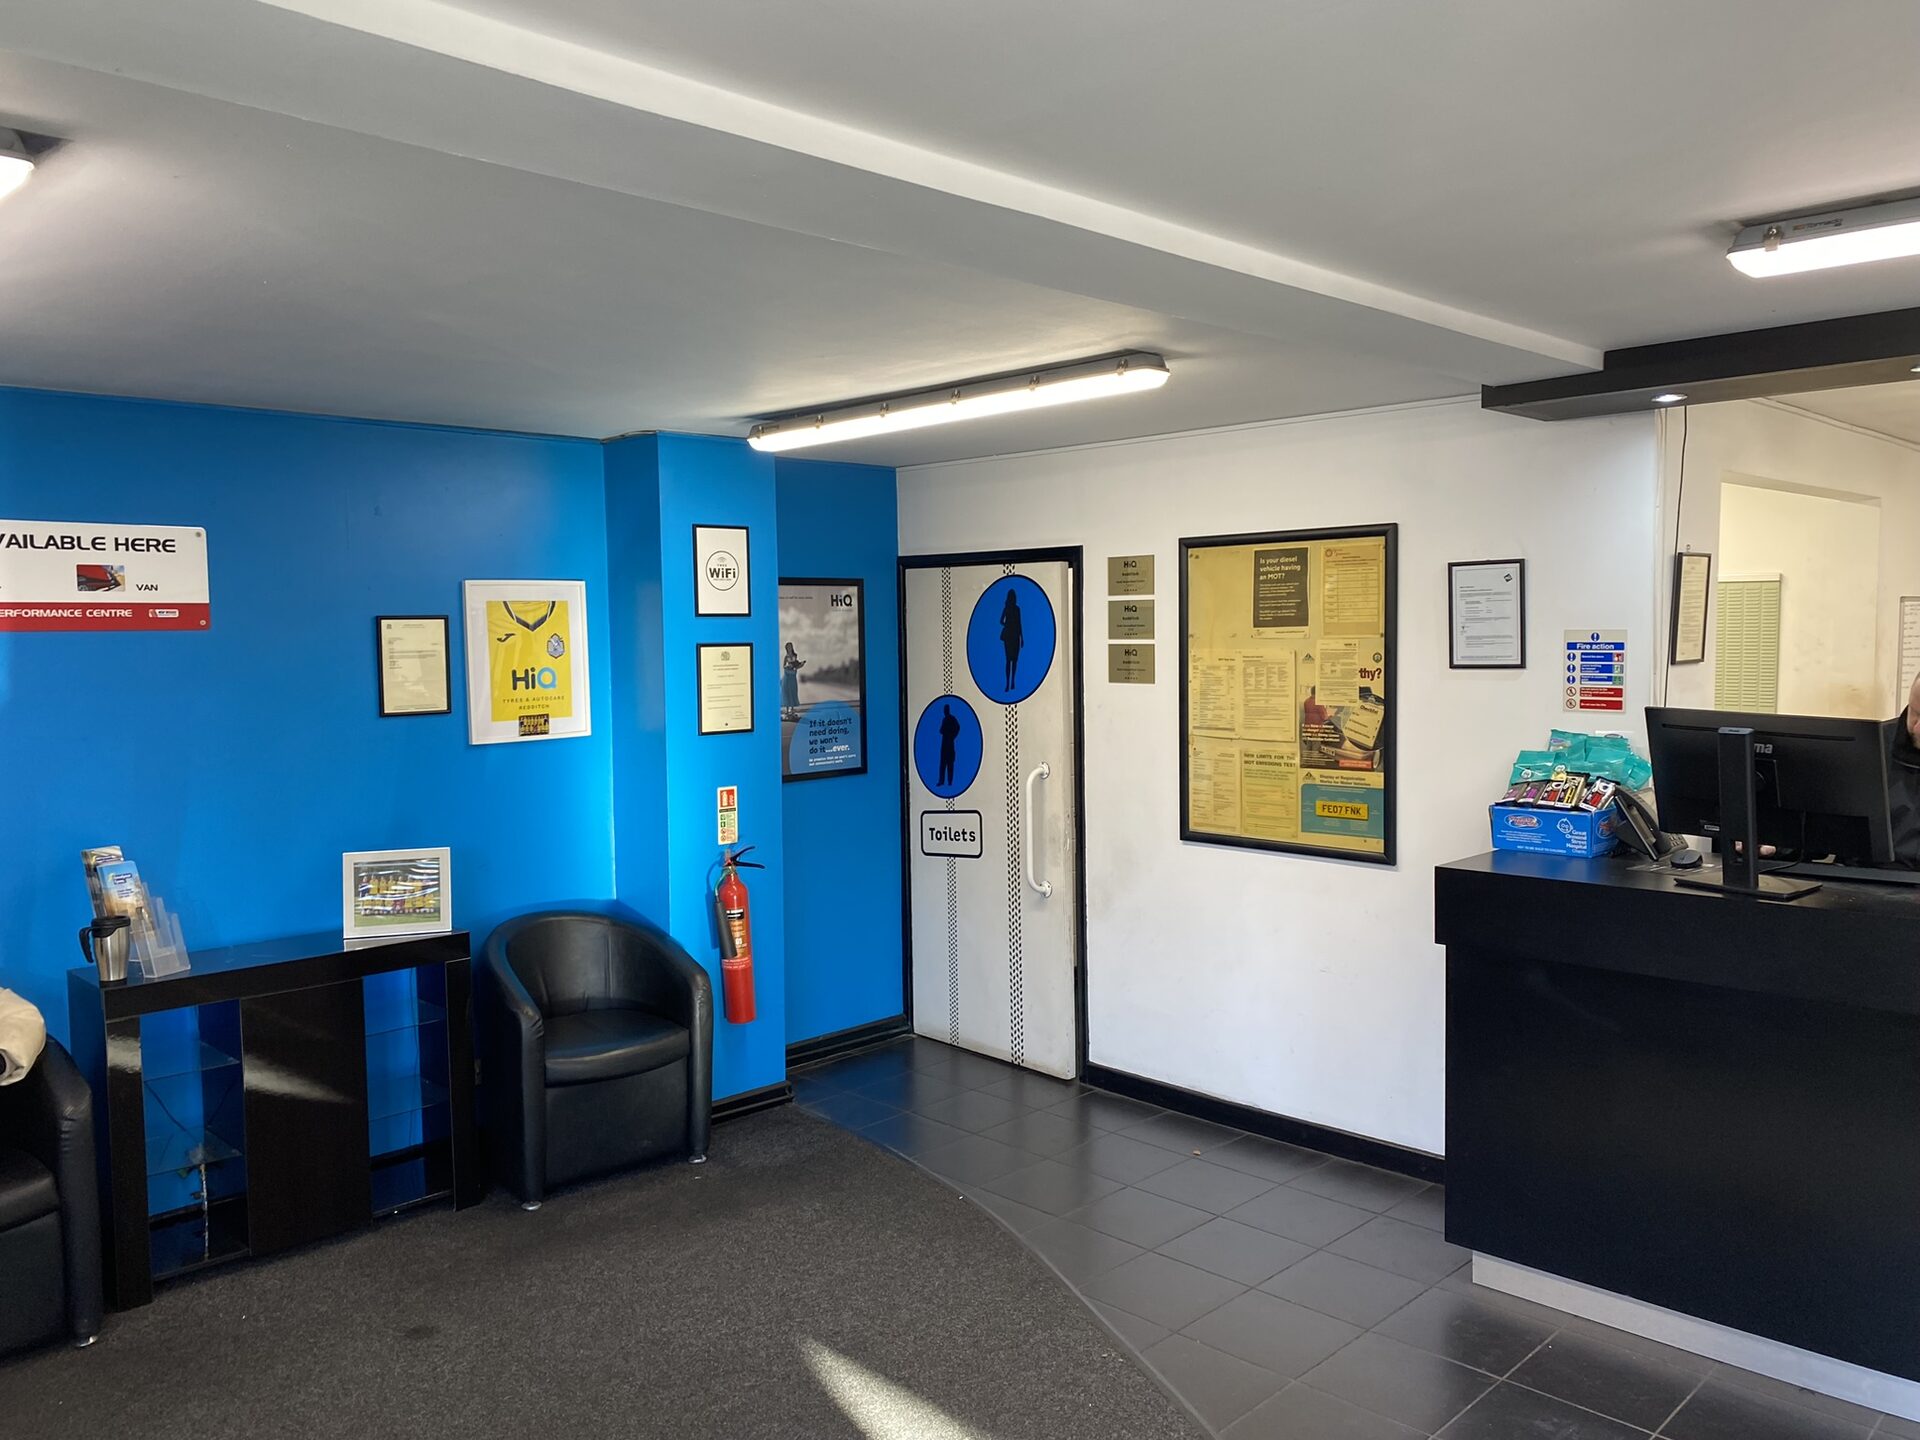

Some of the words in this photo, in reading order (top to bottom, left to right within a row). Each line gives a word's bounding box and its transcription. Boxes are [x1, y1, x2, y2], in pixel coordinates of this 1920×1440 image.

[114, 537, 176, 553] HERE
[709, 567, 736, 579] WiFi
[1281, 564, 1301, 572] having
[136, 583, 159, 592] VAN
[830, 594, 853, 607] HiQ
[86, 609, 133, 617] CENTRE
[512, 667, 557, 690] HiQ
[1359, 667, 1382, 681] thy?
[809, 720, 816, 728] If
[819, 719, 826, 727] it
[828, 718, 852, 726] doesn't
[809, 728, 827, 737] need
[820, 736, 839, 744] won't
[1322, 804, 1343, 814] FE07
[1345, 805, 1362, 816] FNK
[928, 826, 976, 842] Toilets
